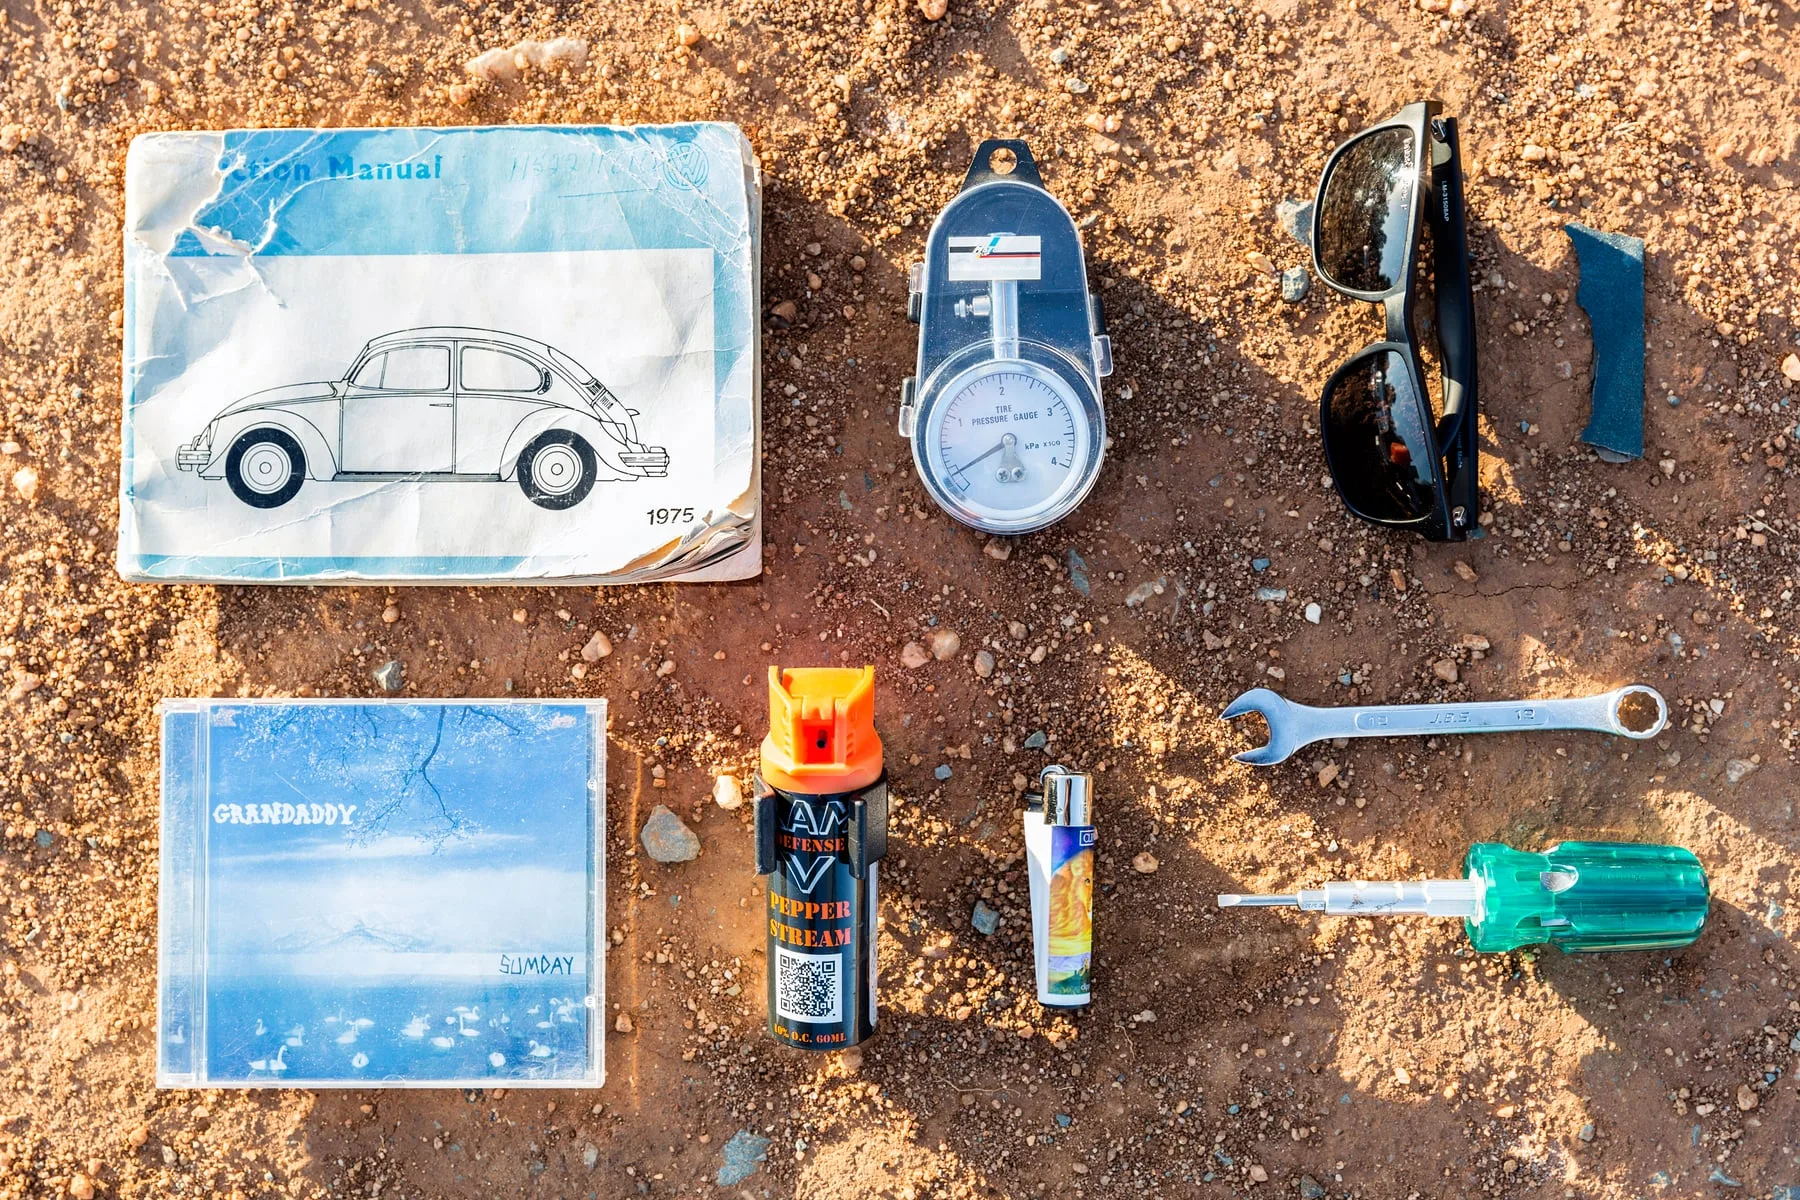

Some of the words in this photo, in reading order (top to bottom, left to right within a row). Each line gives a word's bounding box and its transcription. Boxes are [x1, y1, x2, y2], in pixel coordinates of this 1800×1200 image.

[222, 157, 311, 181] ction
[328, 154, 442, 180] Manual
[999, 386, 1005, 396] 2
[995, 404, 1013, 414] TIRE
[1046, 407, 1053, 417] 3
[958, 418, 963, 427] 1
[972, 414, 1009, 426] PRESSURE
[1013, 411, 1039, 421] GAUGE
[1024, 442, 1039, 450] kPa
[1051, 456, 1057, 466] 4
[646, 507, 694, 525] 1975
[212, 802, 358, 826] GRANDADDY
[770, 890, 852, 920] PEPPER
[770, 918, 852, 948] STREAM
[499, 954, 574, 975] SUMDAY
[774, 1022, 790, 1039] 10%
